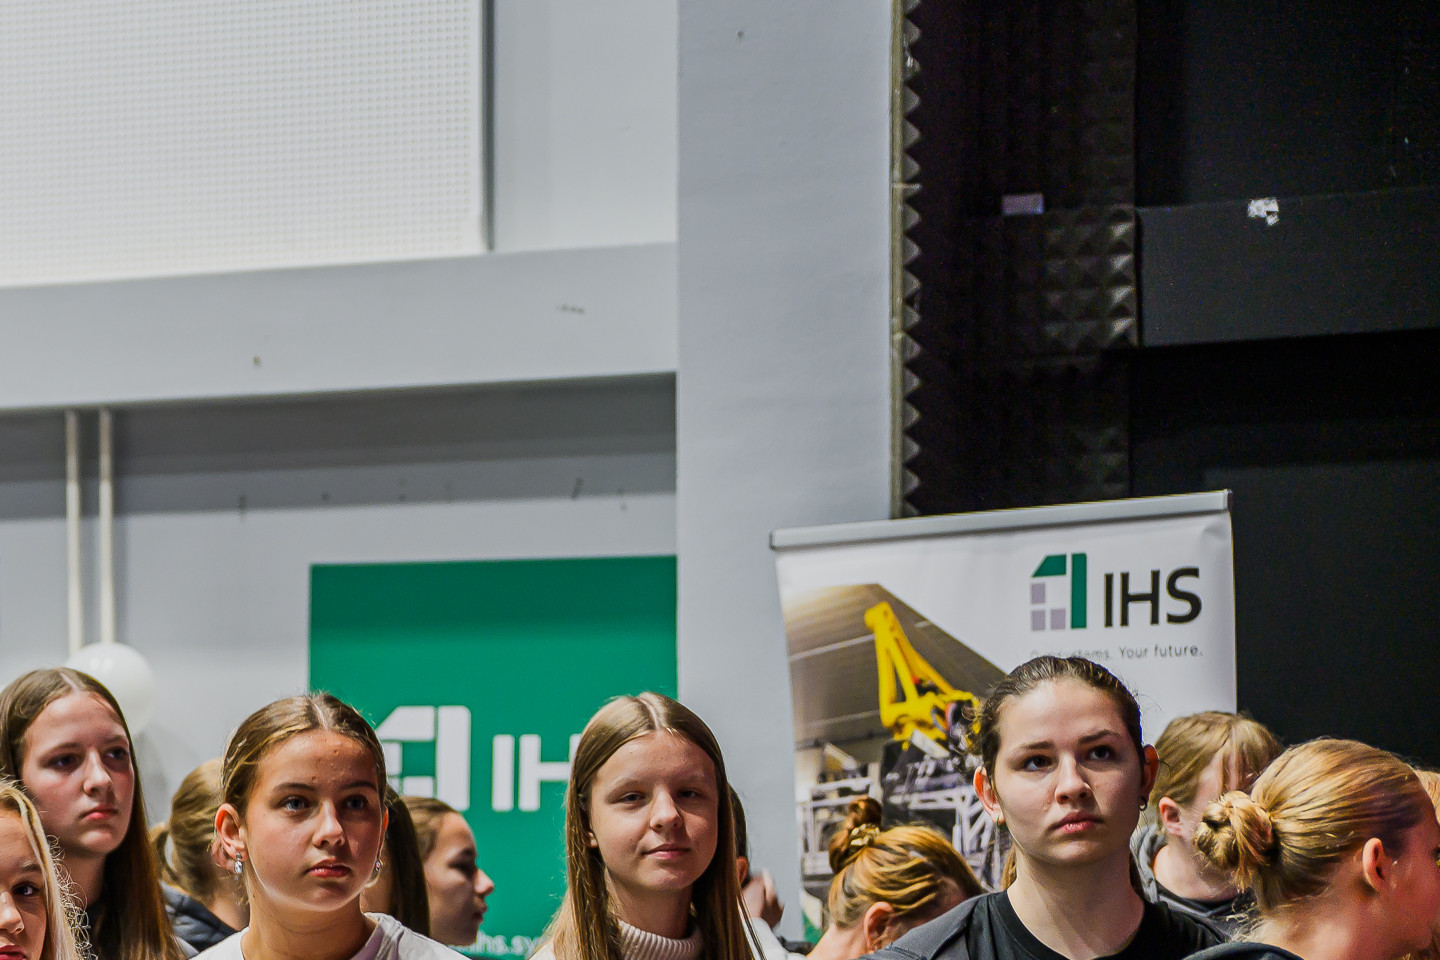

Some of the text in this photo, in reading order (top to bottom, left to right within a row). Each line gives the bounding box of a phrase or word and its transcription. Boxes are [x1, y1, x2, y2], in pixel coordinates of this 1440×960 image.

[1104, 566, 1202, 628] IHS
[1119, 645, 1148, 660] Your
[1154, 643, 1203, 659] future.
[491, 733, 583, 812] IH
